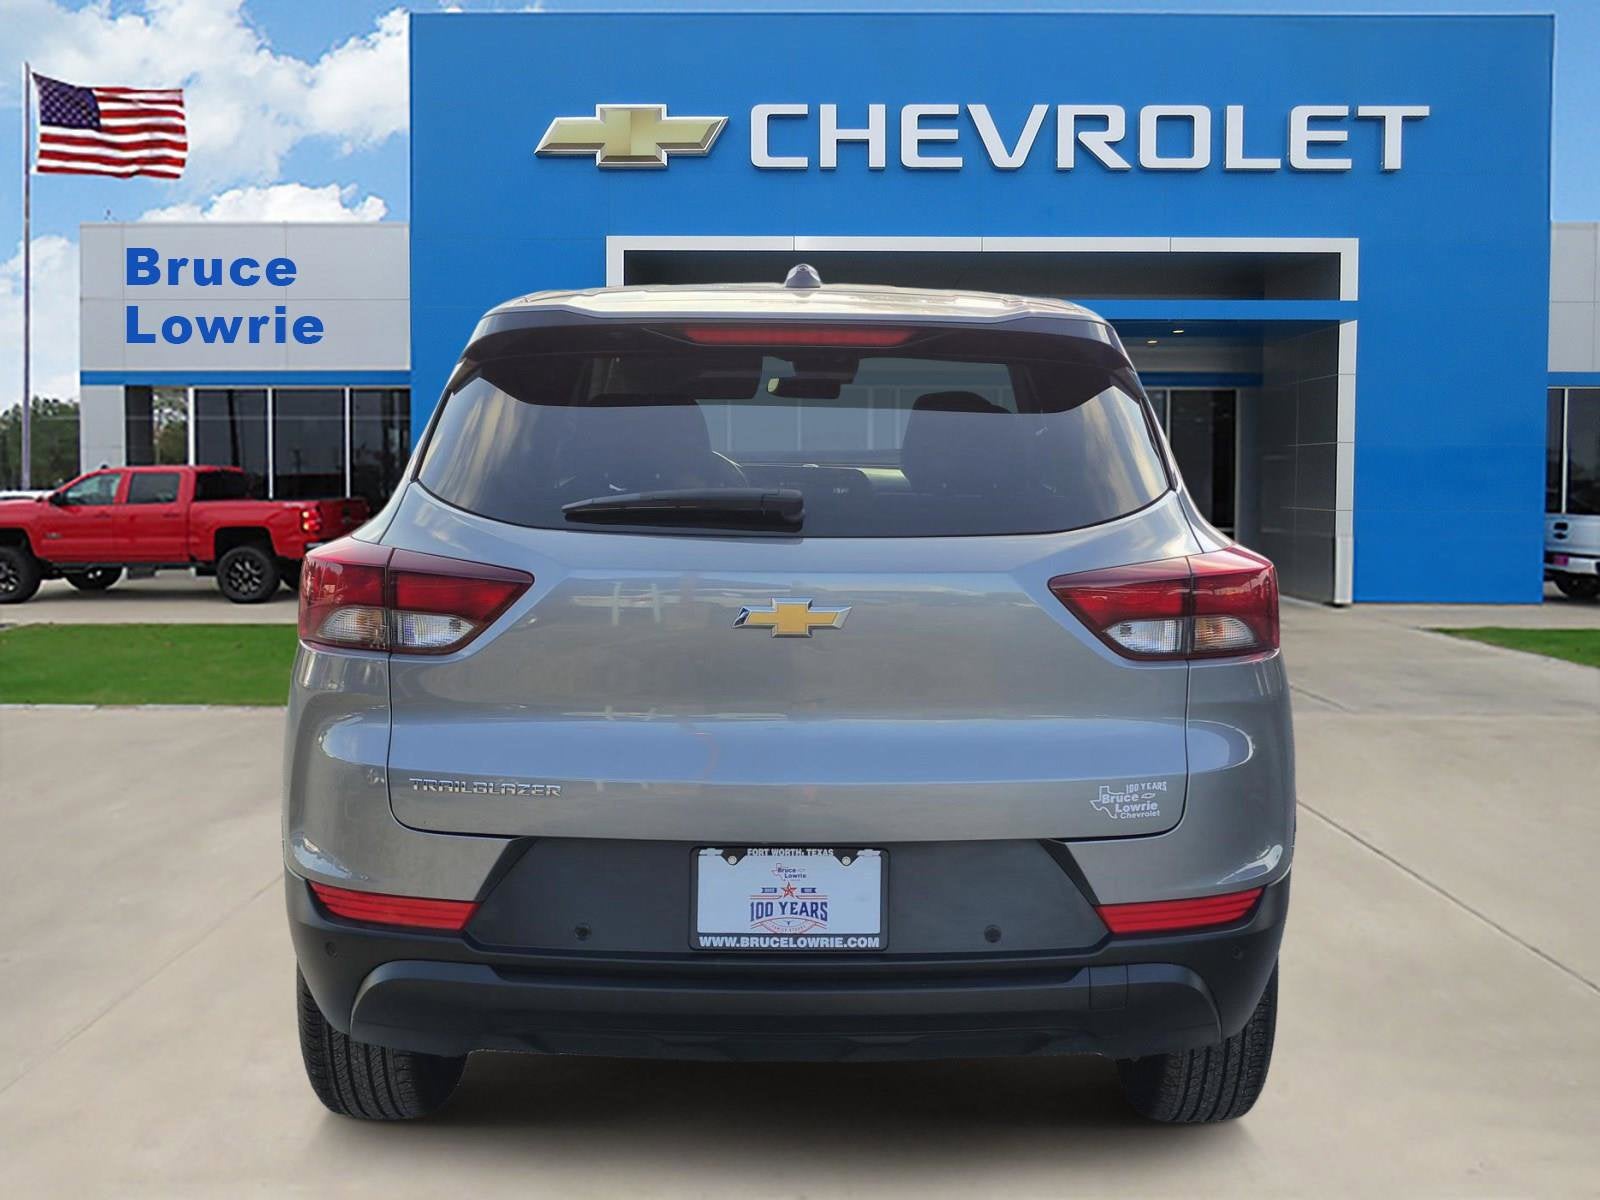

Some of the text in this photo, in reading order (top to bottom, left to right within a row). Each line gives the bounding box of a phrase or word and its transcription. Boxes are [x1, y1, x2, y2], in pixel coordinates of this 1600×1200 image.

[750, 103, 1430, 171] CHEVROLET
[125, 246, 298, 288] Bruce
[125, 304, 325, 346] Lowrie
[409, 778, 562, 796] TRAILBLAZER
[1126, 781, 1167, 794] 100 YEARS
[1102, 793, 1139, 804] Bruce
[1115, 800, 1158, 813] Lowrie
[1120, 810, 1160, 819] Chevrolet
[747, 848, 770, 857] FORT
[806, 848, 834, 857] TEXAS
[750, 901, 828, 922] 100 YEARS
[699, 936, 881, 949] WWW.BRUCELOWRIE.COM
